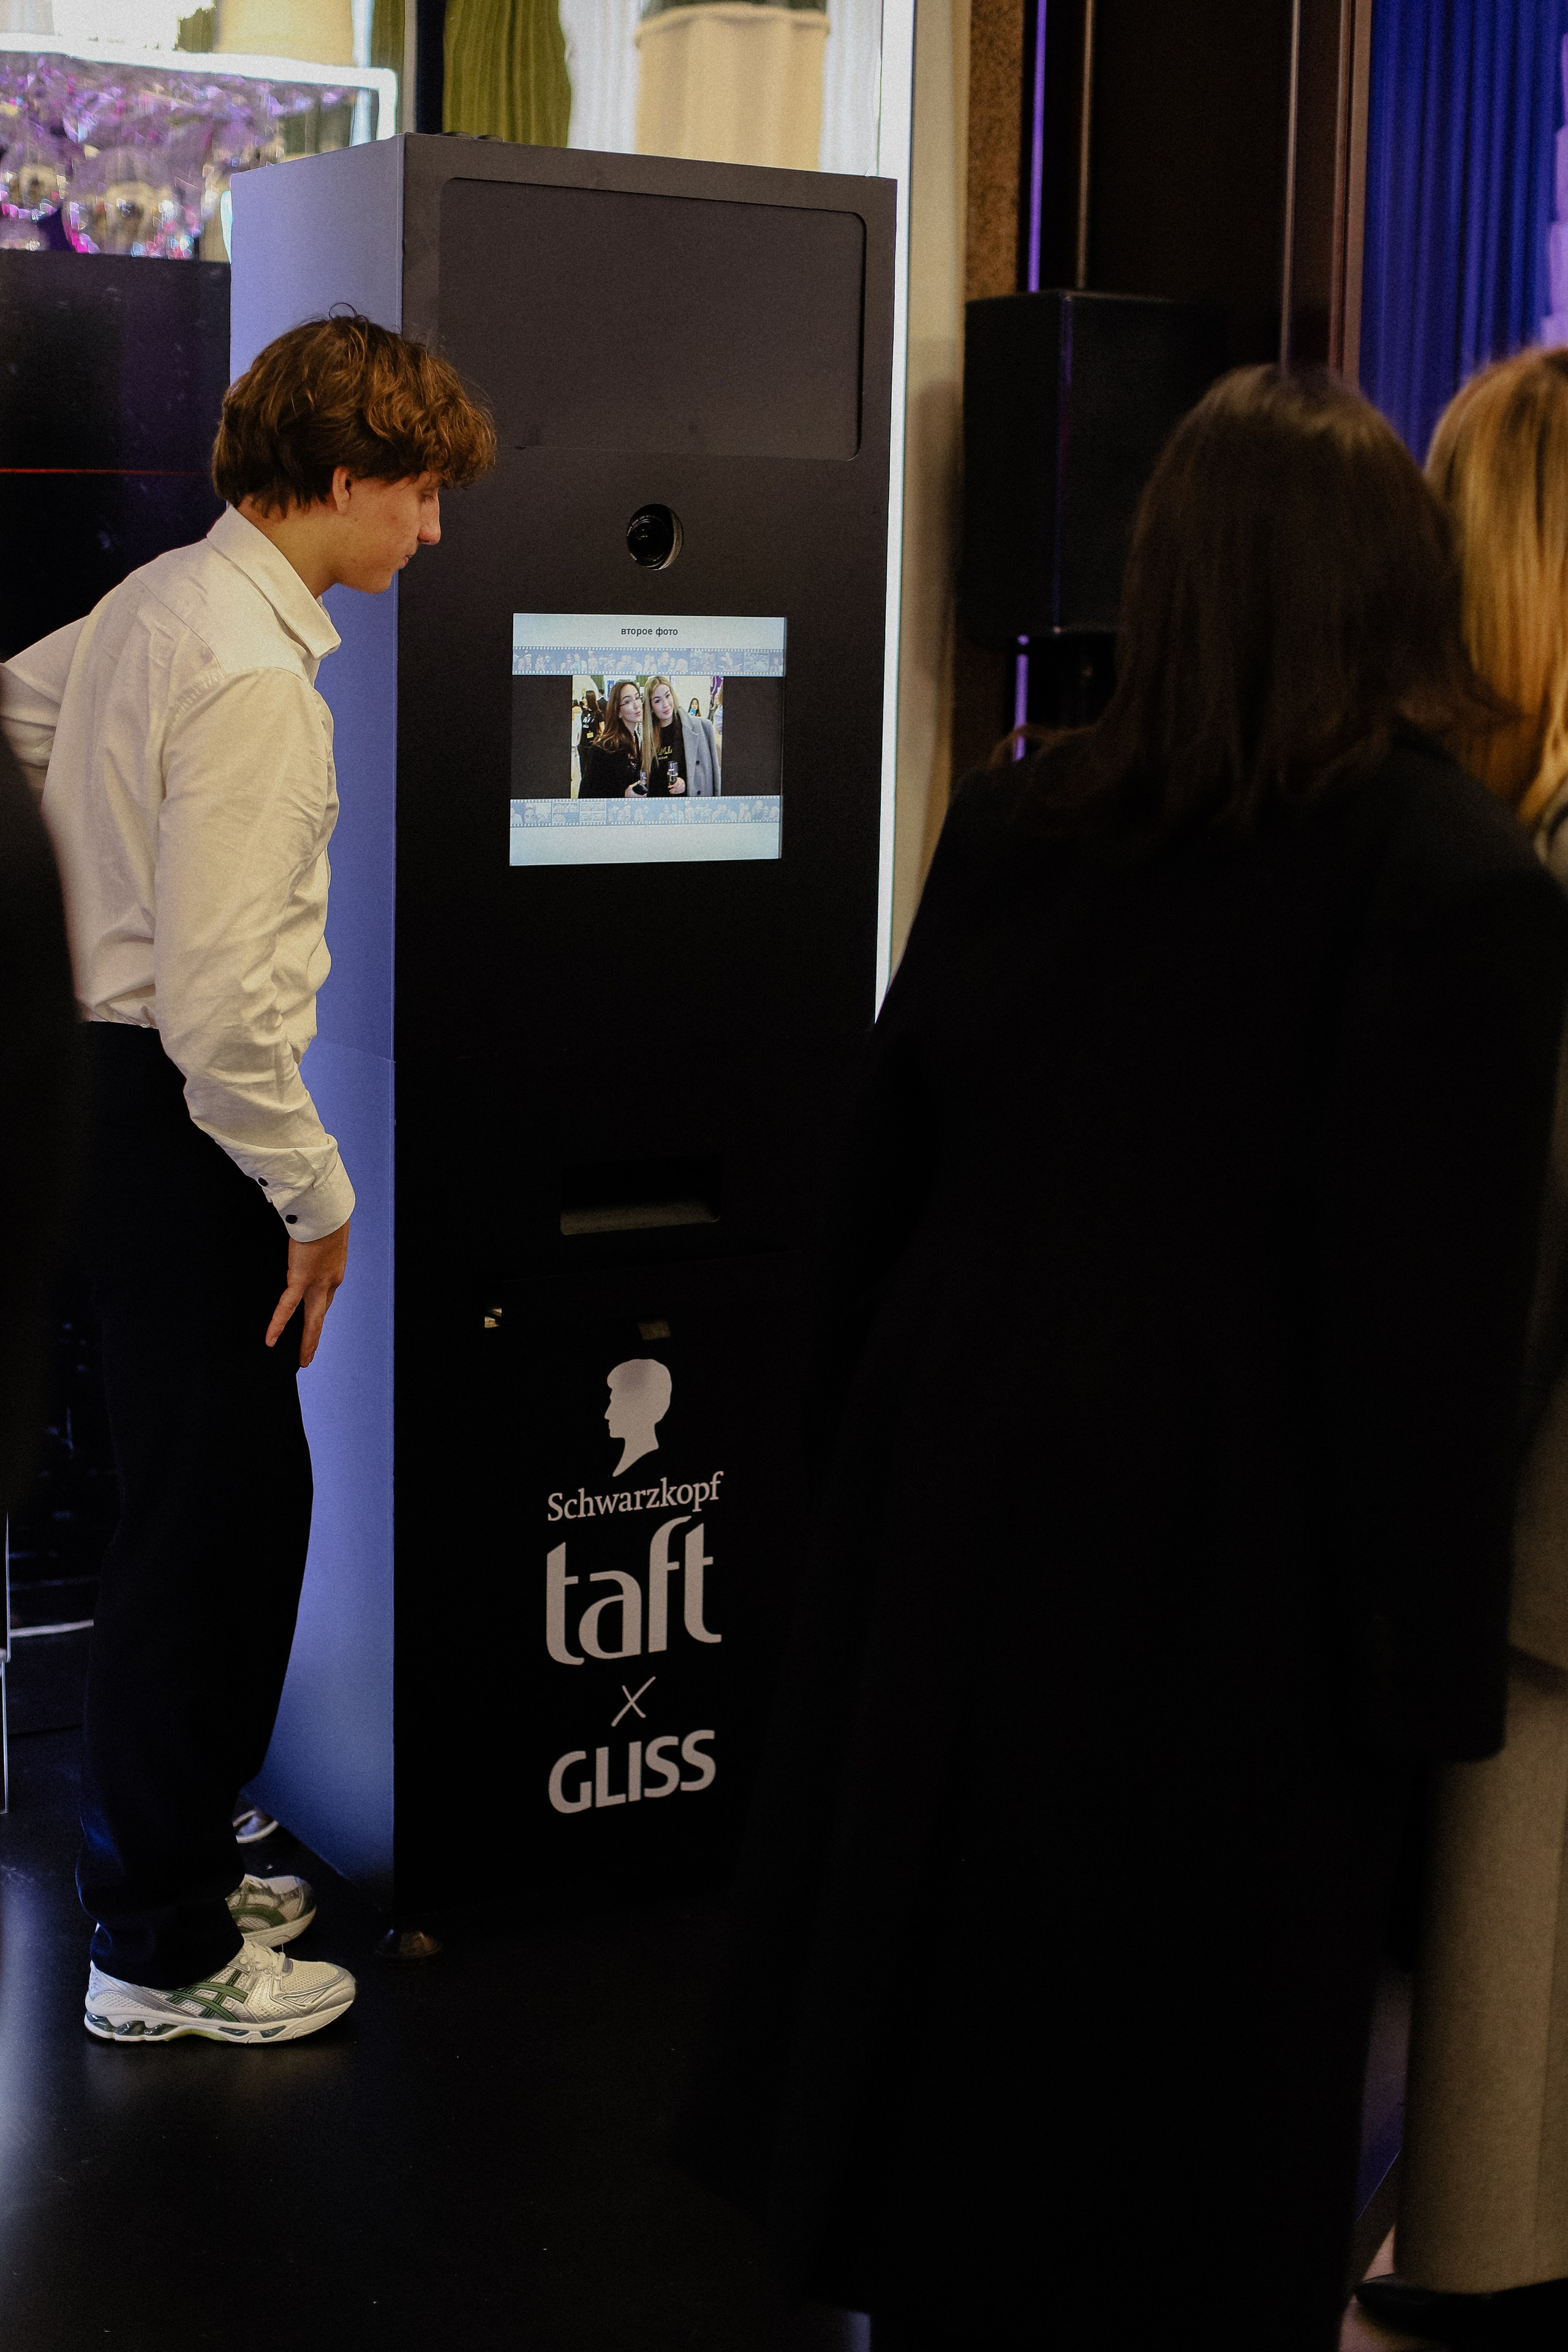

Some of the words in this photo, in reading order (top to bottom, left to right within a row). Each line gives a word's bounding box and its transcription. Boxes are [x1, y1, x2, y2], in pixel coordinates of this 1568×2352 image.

[620, 628, 653, 637] второе
[655, 627, 678, 637] фото
[548, 1470, 725, 1521] Schwarzkopf
[546, 1515, 722, 1665] taft
[548, 1729, 717, 1814] GLISS
